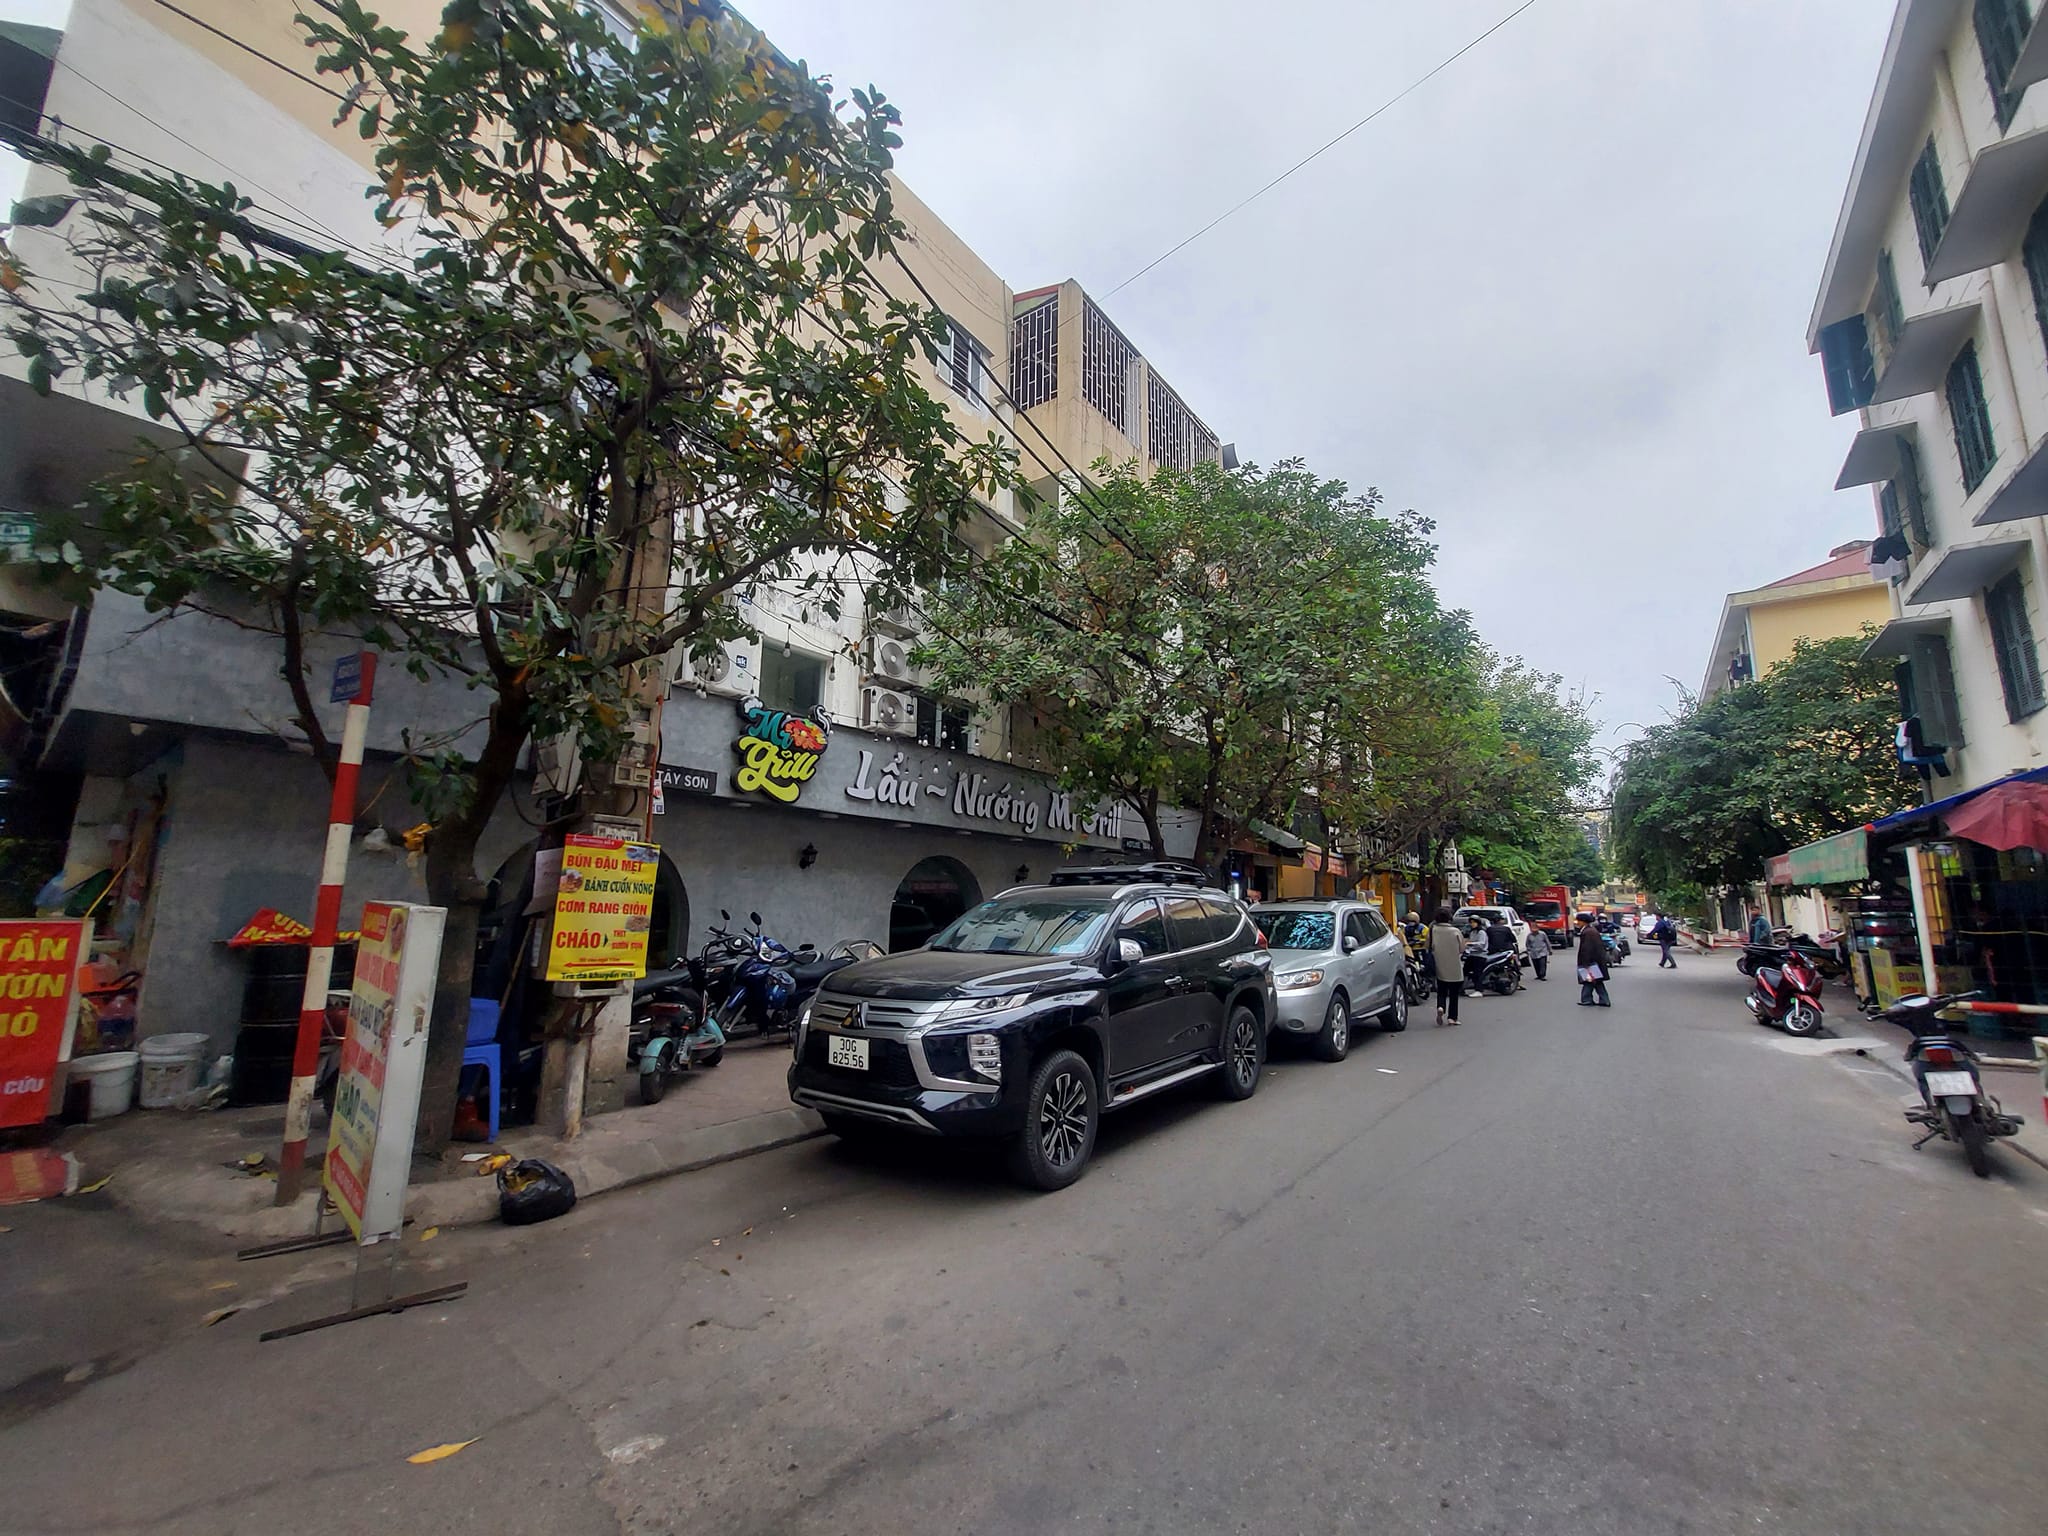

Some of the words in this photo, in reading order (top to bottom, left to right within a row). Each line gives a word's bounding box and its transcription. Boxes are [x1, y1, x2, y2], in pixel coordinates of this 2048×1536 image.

[748, 708, 793, 749] Mr
[737, 736, 819, 802] Grill
[656, 769, 681, 785] TÂY
[684, 774, 709, 790] SƠN
[846, 751, 918, 807] Lẩu
[953, 771, 1039, 834] Nướng
[566, 854, 592, 868] BÚN
[595, 856, 618, 872] ĐẬU
[558, 900, 585, 914] CƠM
[588, 902, 619, 914] RANG
[556, 929, 601, 949] CHÁO
[839, 1038, 857, 1052] 30G
[832, 1051, 864, 1068] 825.56
